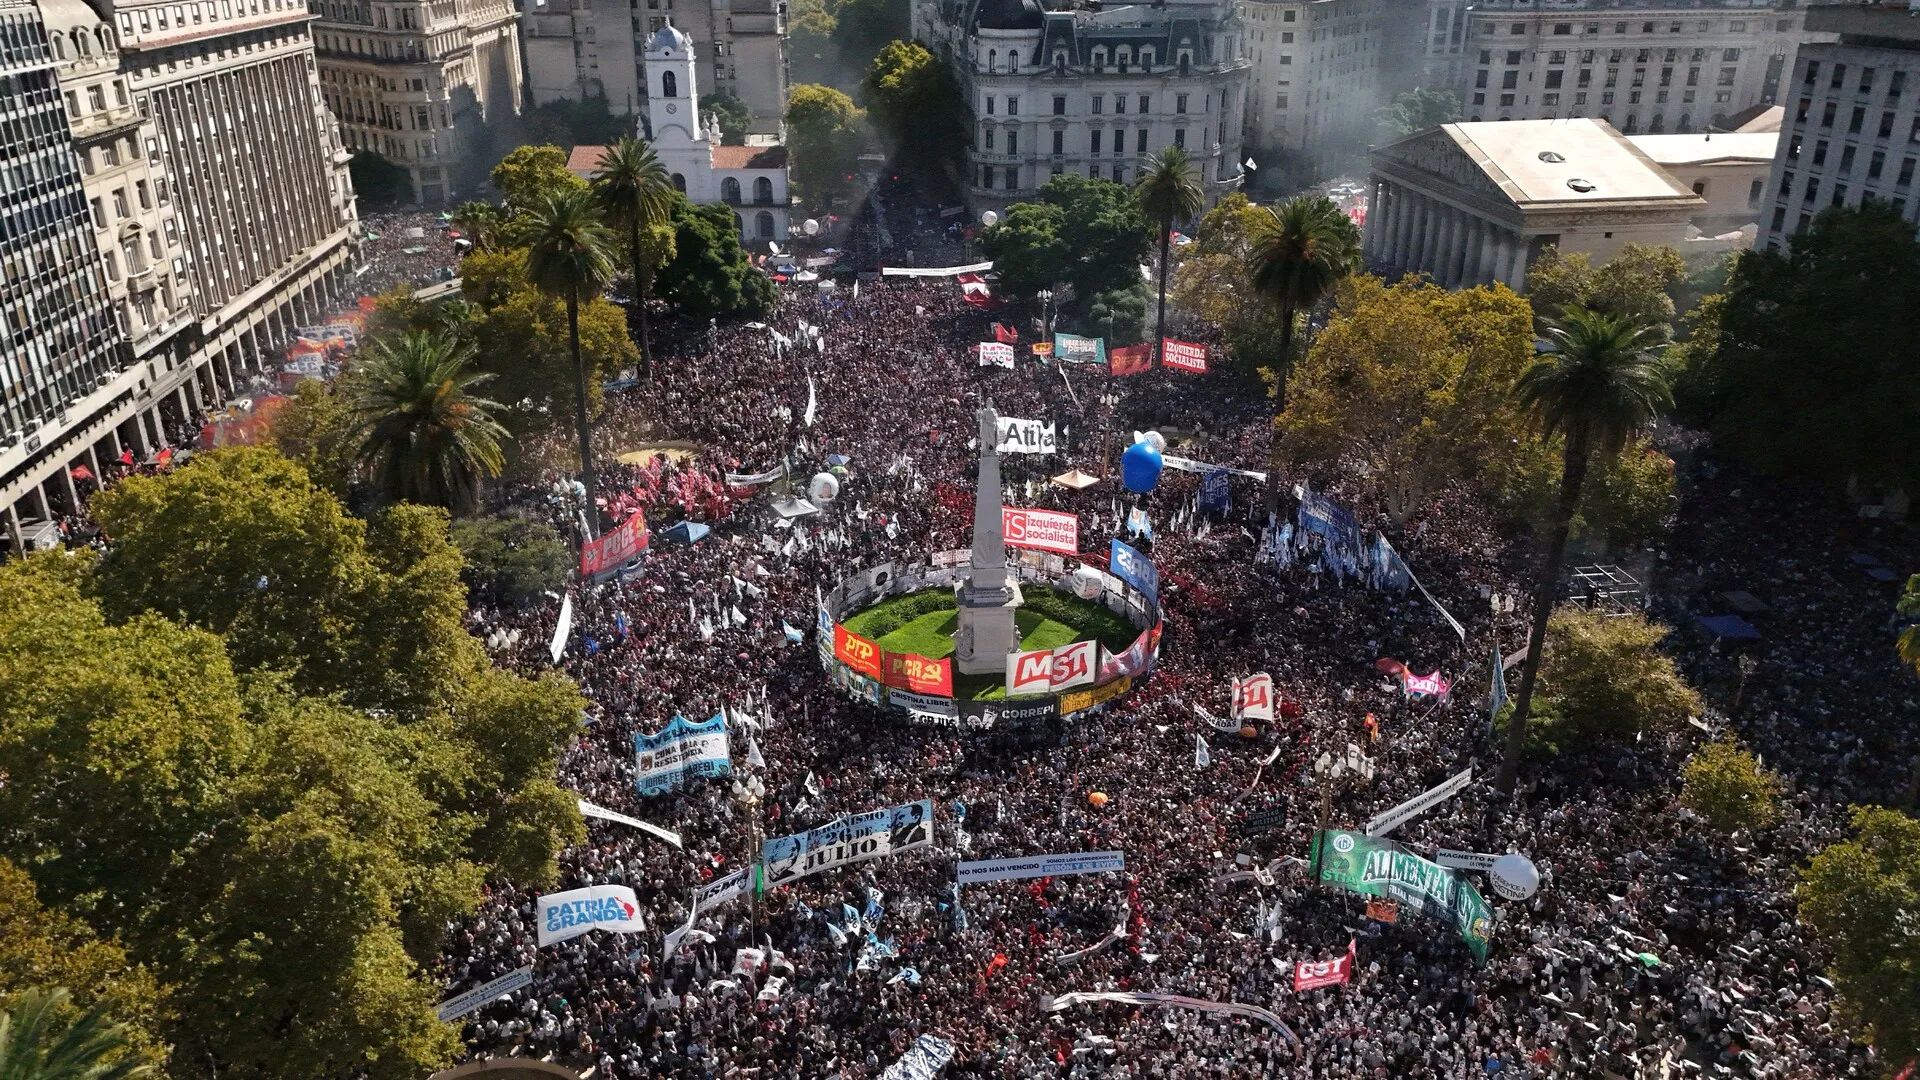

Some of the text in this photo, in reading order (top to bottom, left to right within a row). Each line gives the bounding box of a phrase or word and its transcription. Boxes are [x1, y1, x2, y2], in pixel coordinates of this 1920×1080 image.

[1166, 341, 1205, 359] IZQUIERDA
[1165, 352, 1206, 370] SOCIALISTA
[1027, 514, 1075, 533] izquierda
[1026, 529, 1075, 545] socialista
[892, 658, 923, 678] PCR
[1020, 652, 1085, 682] MST
[890, 691, 925, 704] CRISTINA
[926, 697, 950, 707] LIBRE
[1002, 704, 1055, 719] CORREPI
[654, 746, 677, 760] CUNA
[654, 749, 704, 769] RESISTENCIA
[807, 811, 885, 841] PERONISMO
[825, 826, 873, 846] 26 DE
[803, 838, 878, 871] JULIO
[1439, 852, 1485, 861] MAGNETTO
[959, 868, 970, 876] NO
[989, 865, 1005, 873] HAN
[1006, 863, 1040, 871] VENCIDO
[1095, 861, 1120, 870] EVITA
[1388, 885, 1409, 901] FILIAL
[547, 896, 620, 921] PATRIA
[547, 908, 629, 932] GRANDE
[445, 996, 469, 1009] SOMOS
